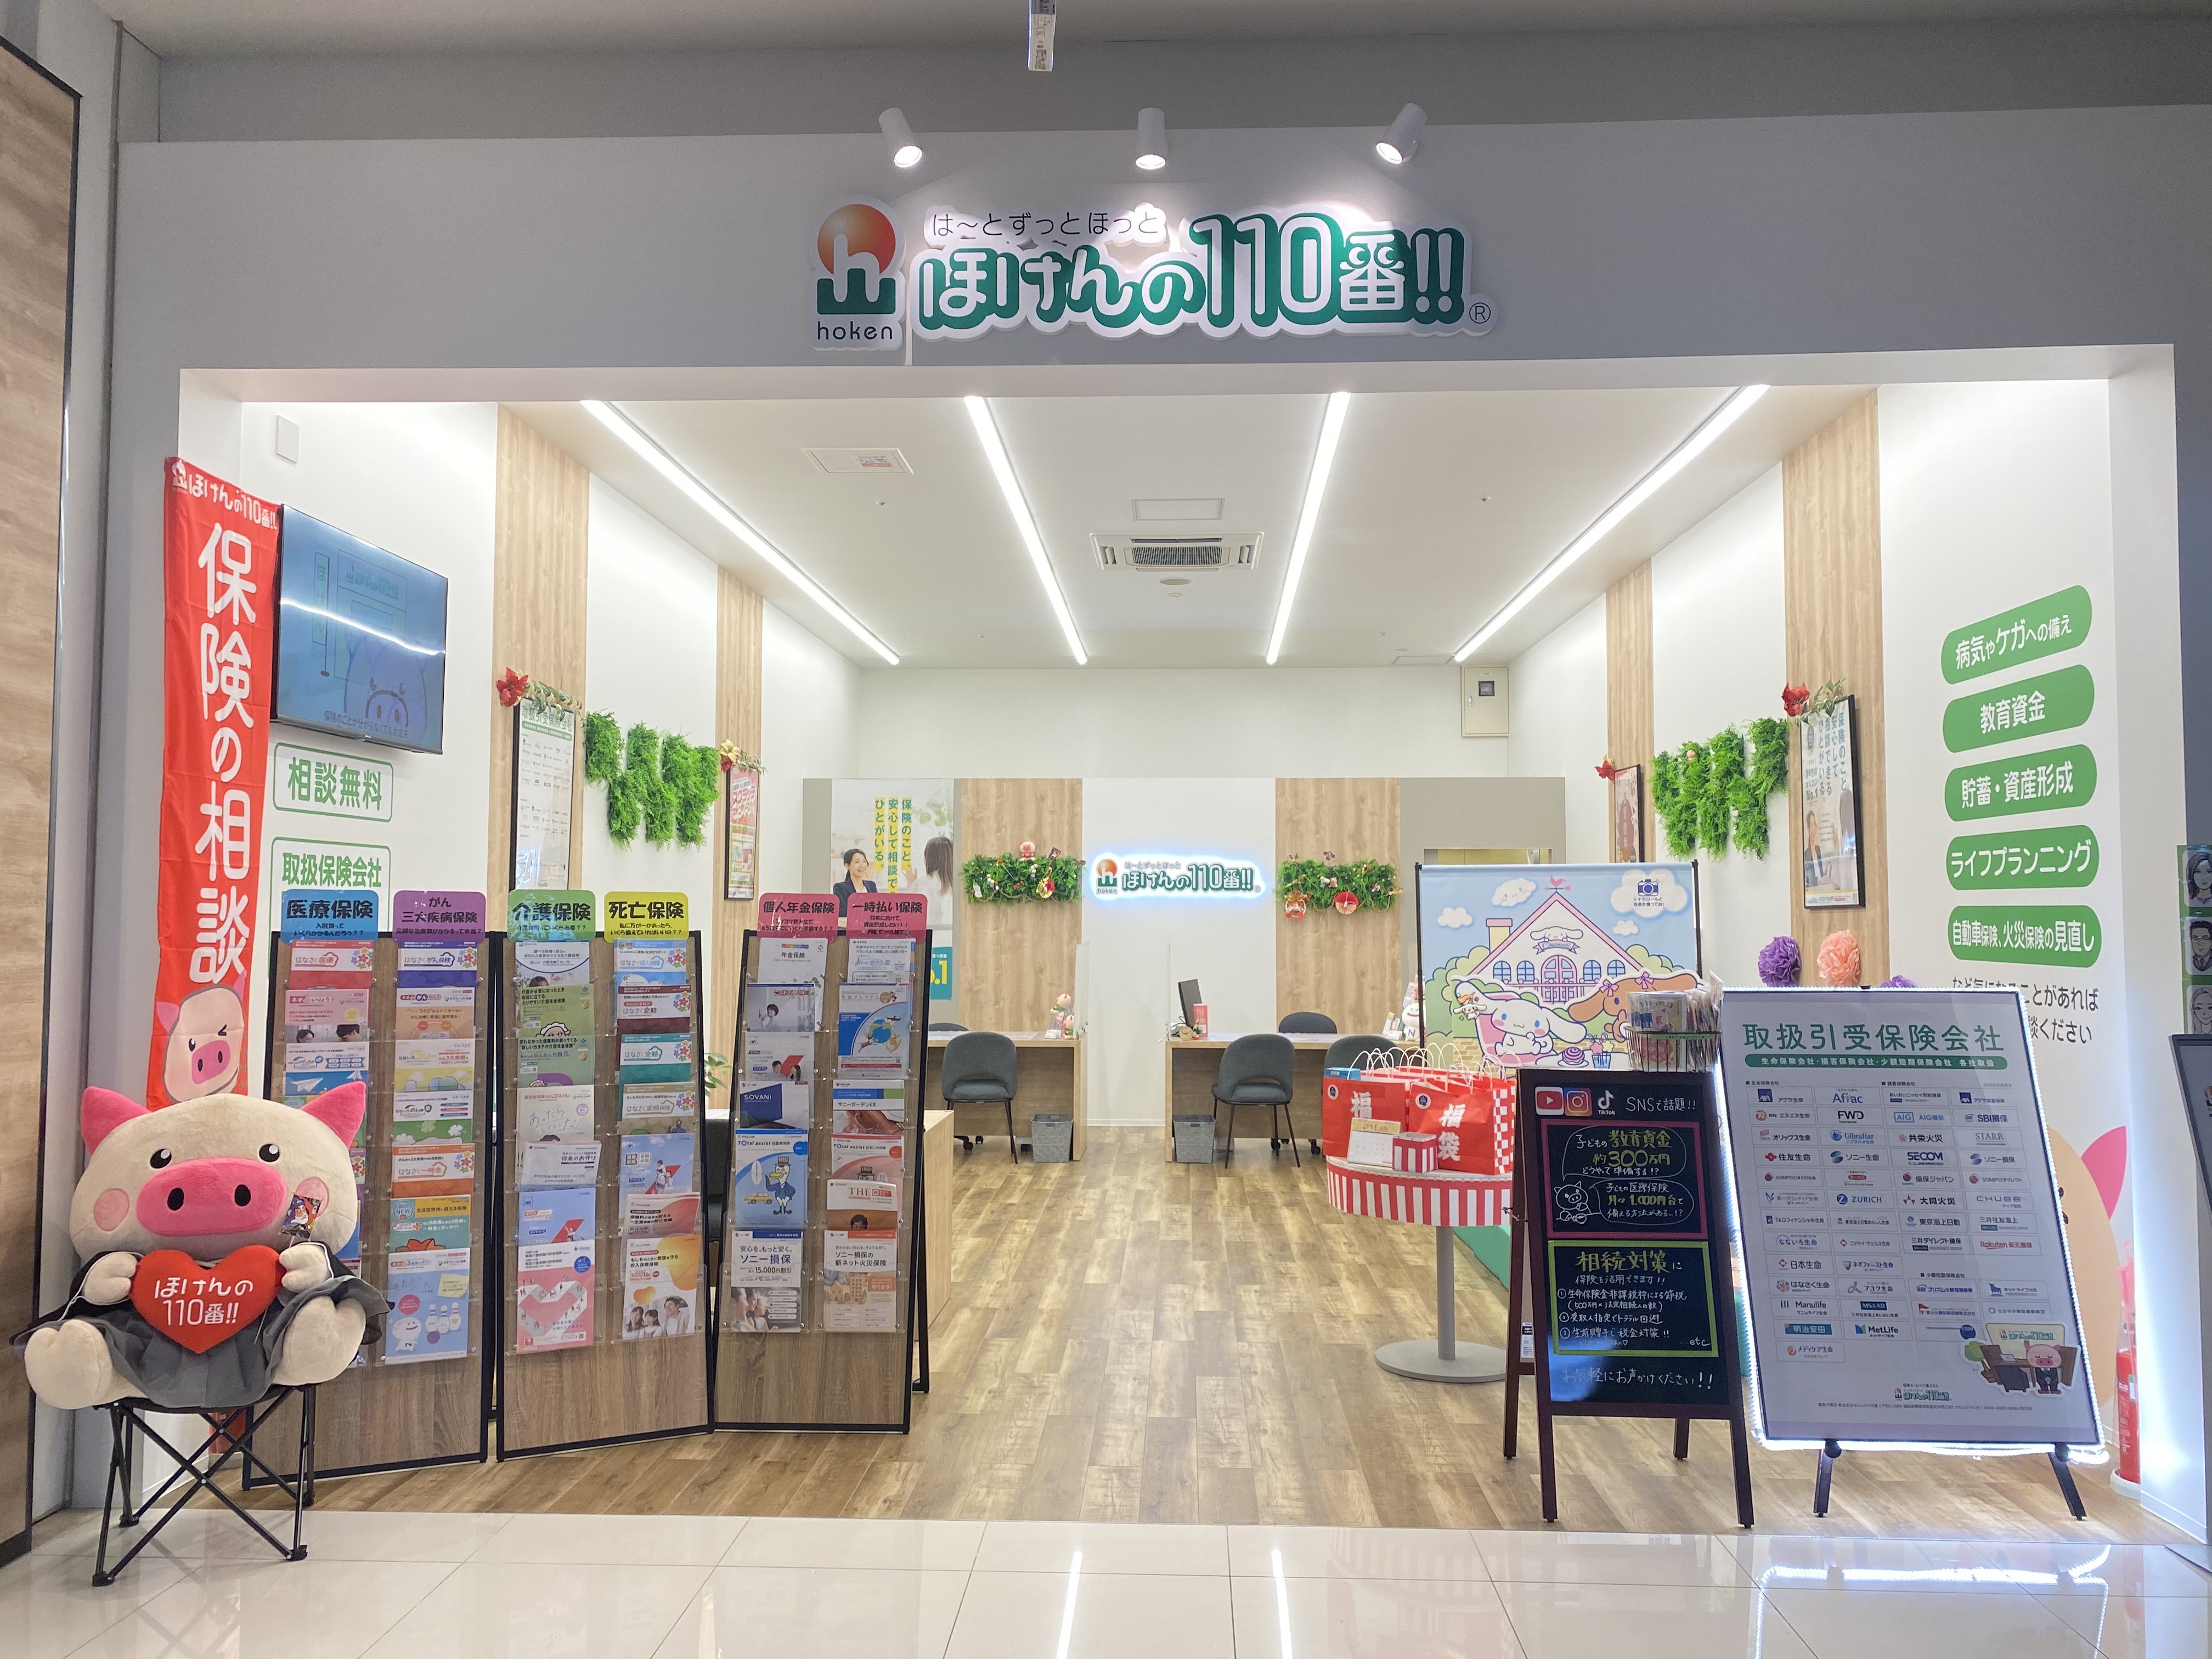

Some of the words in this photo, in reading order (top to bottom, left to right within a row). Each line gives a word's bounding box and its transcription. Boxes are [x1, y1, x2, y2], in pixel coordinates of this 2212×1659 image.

[918, 212, 1465, 329] ほけんの110番!!
[816, 321, 894, 341] hoken
[188, 473, 278, 531] ほけんの110番!!
[1956, 613, 2073, 670] 病気やケガへの備え
[1980, 690, 2046, 735] 教育資金
[189, 522, 257, 984] 保険の相談
[287, 755, 382, 811] 相談無料
[1962, 763, 2074, 809] 貯蓄・資産形成
[1950, 839, 2092, 878] ライフプランニング
[281, 851, 382, 888] 取扱保険会社
[287, 899, 374, 919] 医療保険
[428, 896, 452, 908] がん
[608, 901, 685, 919] 死亡保険
[763, 901, 835, 915] 個人年金保険
[851, 901, 923, 914] 一時払い保険
[401, 911, 478, 923] 三大疾病保険
[512, 902, 591, 921] 介護保険
[1952, 919, 2095, 953] 自動車保険、火災保険の見直し
[1742, 1023, 2004, 1052] 取扱引受保険会社
[1350, 1090, 1373, 1119] 福
[1626, 1096, 1696, 1112] SNSで話題!!
[1832, 1092, 1863, 1103] Aflac
[1837, 1110, 1864, 1120] FWD
[1977, 1114, 2008, 1122] SBI損保
[1437, 1103, 1466, 1162] 福袋
[1575, 1130, 1672, 1149] 子どもの教育資金
[1909, 1133, 1943, 1143] 共栄火災
[1592, 1149, 1671, 1167] 約300万円
[1779, 1153, 1811, 1161] 住友生命
[1907, 1152, 1943, 1161] SECOM
[848, 1187, 872, 1197] THE
[1605, 1182, 1670, 1193] 子どもの医療保険
[1920, 1197, 1956, 1205] 大同火災
[740, 1254, 791, 1265] ソニー損保
[1575, 1250, 1683, 1274] 相続対策に
[1790, 1260, 1822, 1269] 日本生命
[154, 1276, 253, 1300] ほけんの
[1575, 1274, 1666, 1285] 保険を活用できます!!
[163, 1299, 239, 1327] 110番!!
[1795, 1300, 1827, 1308] Manulife
[1793, 1325, 1826, 1334] 明治安田
[1868, 1325, 1899, 1334] MetLife
